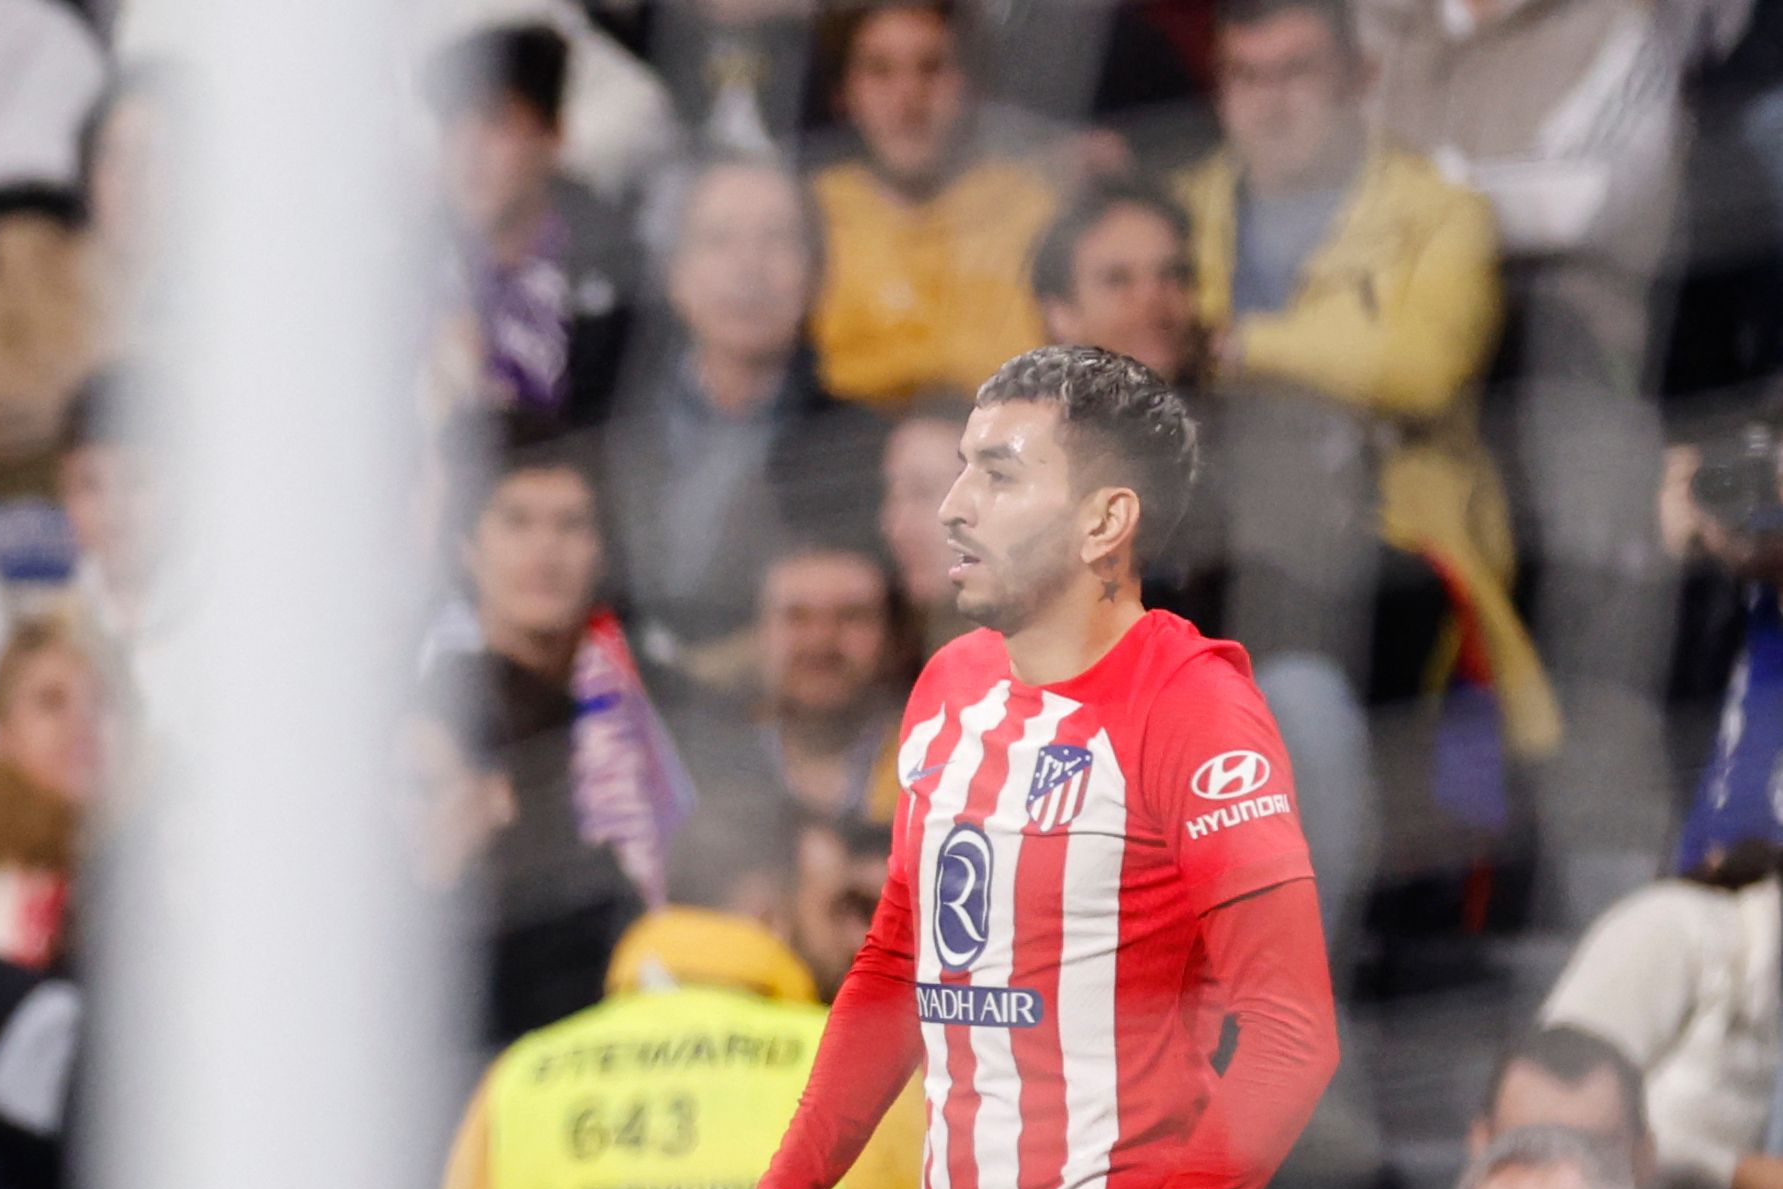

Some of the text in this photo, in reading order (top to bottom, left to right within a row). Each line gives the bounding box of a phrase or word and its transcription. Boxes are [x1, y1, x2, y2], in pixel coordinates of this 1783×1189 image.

[1186, 793, 1290, 840] HYUNDAI
[916, 987, 1036, 1024] IYADH AIR
[530, 1034, 804, 1084] STEWARD
[568, 1095, 697, 1159] 643
